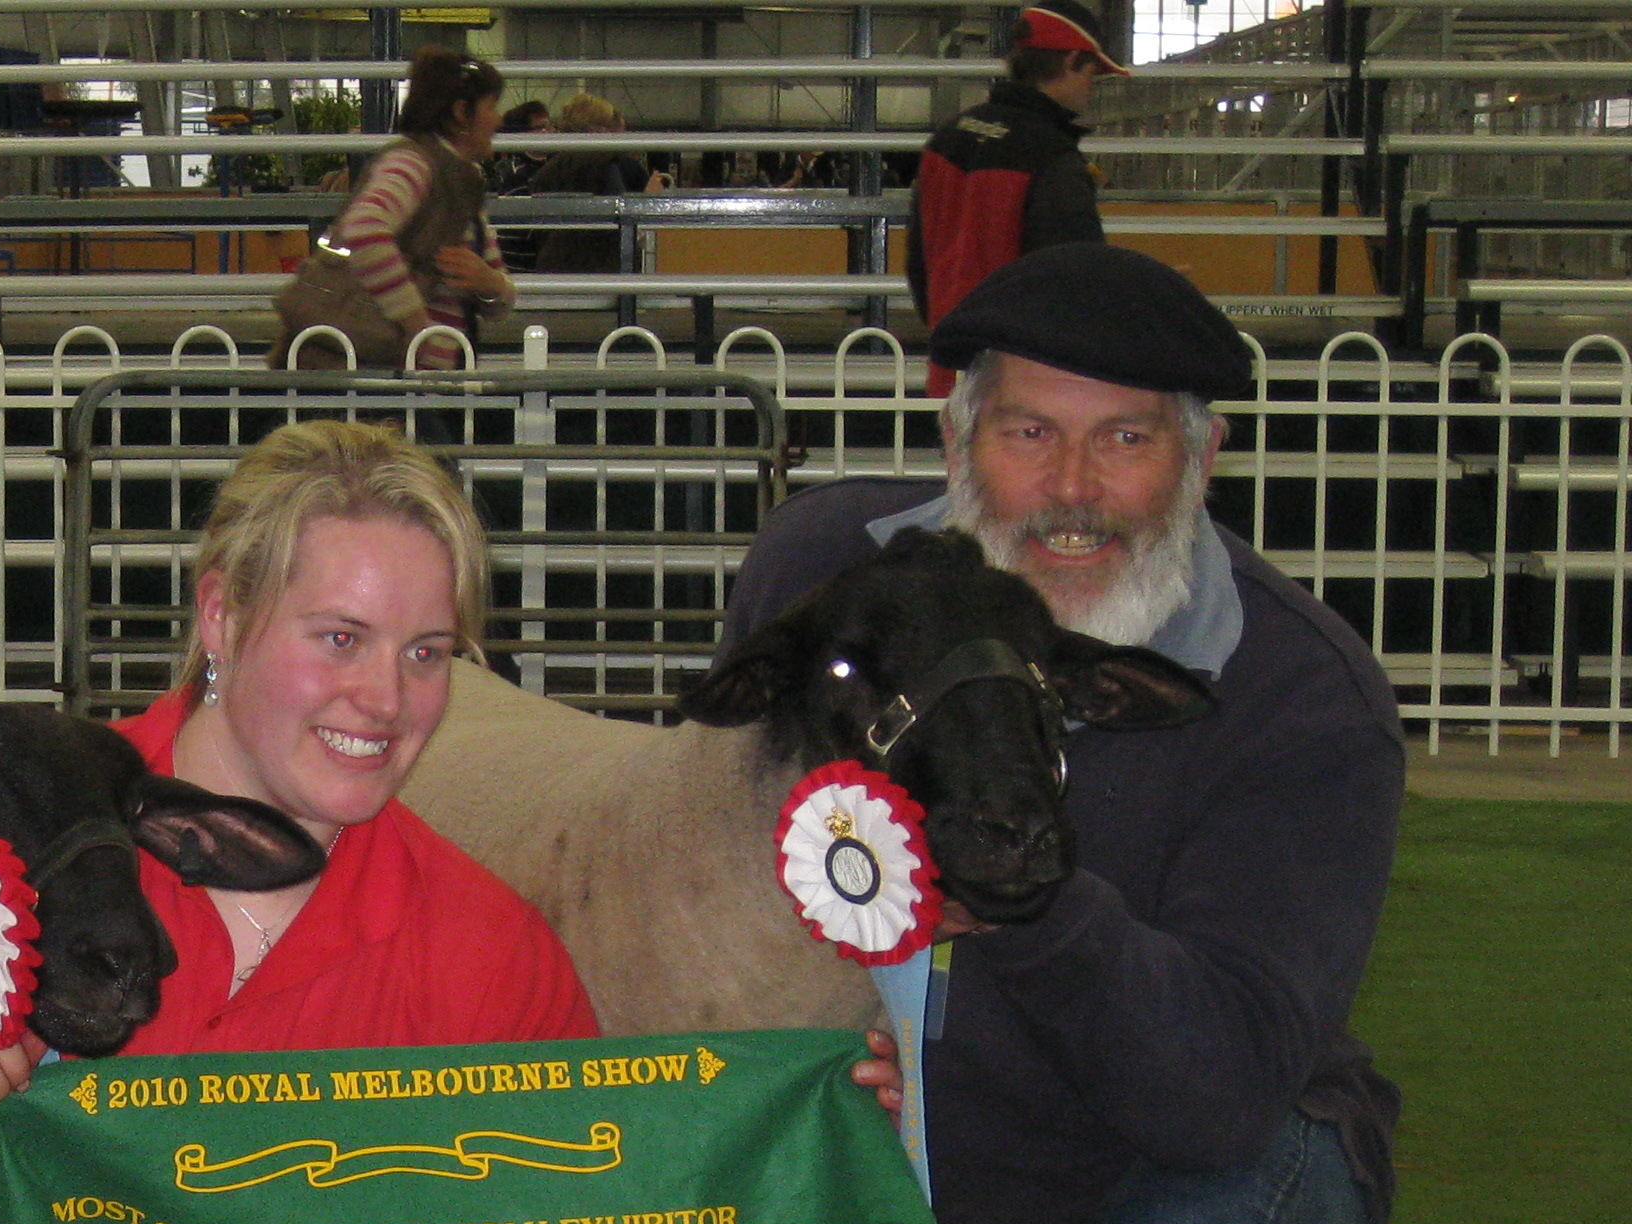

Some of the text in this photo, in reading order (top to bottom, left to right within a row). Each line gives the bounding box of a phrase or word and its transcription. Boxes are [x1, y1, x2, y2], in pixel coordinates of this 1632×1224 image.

[1218, 305, 1335, 316] LIPPERY WHEN WET
[108, 1054, 690, 1110] 2010 ROYAL MELBOURNE SHOW
